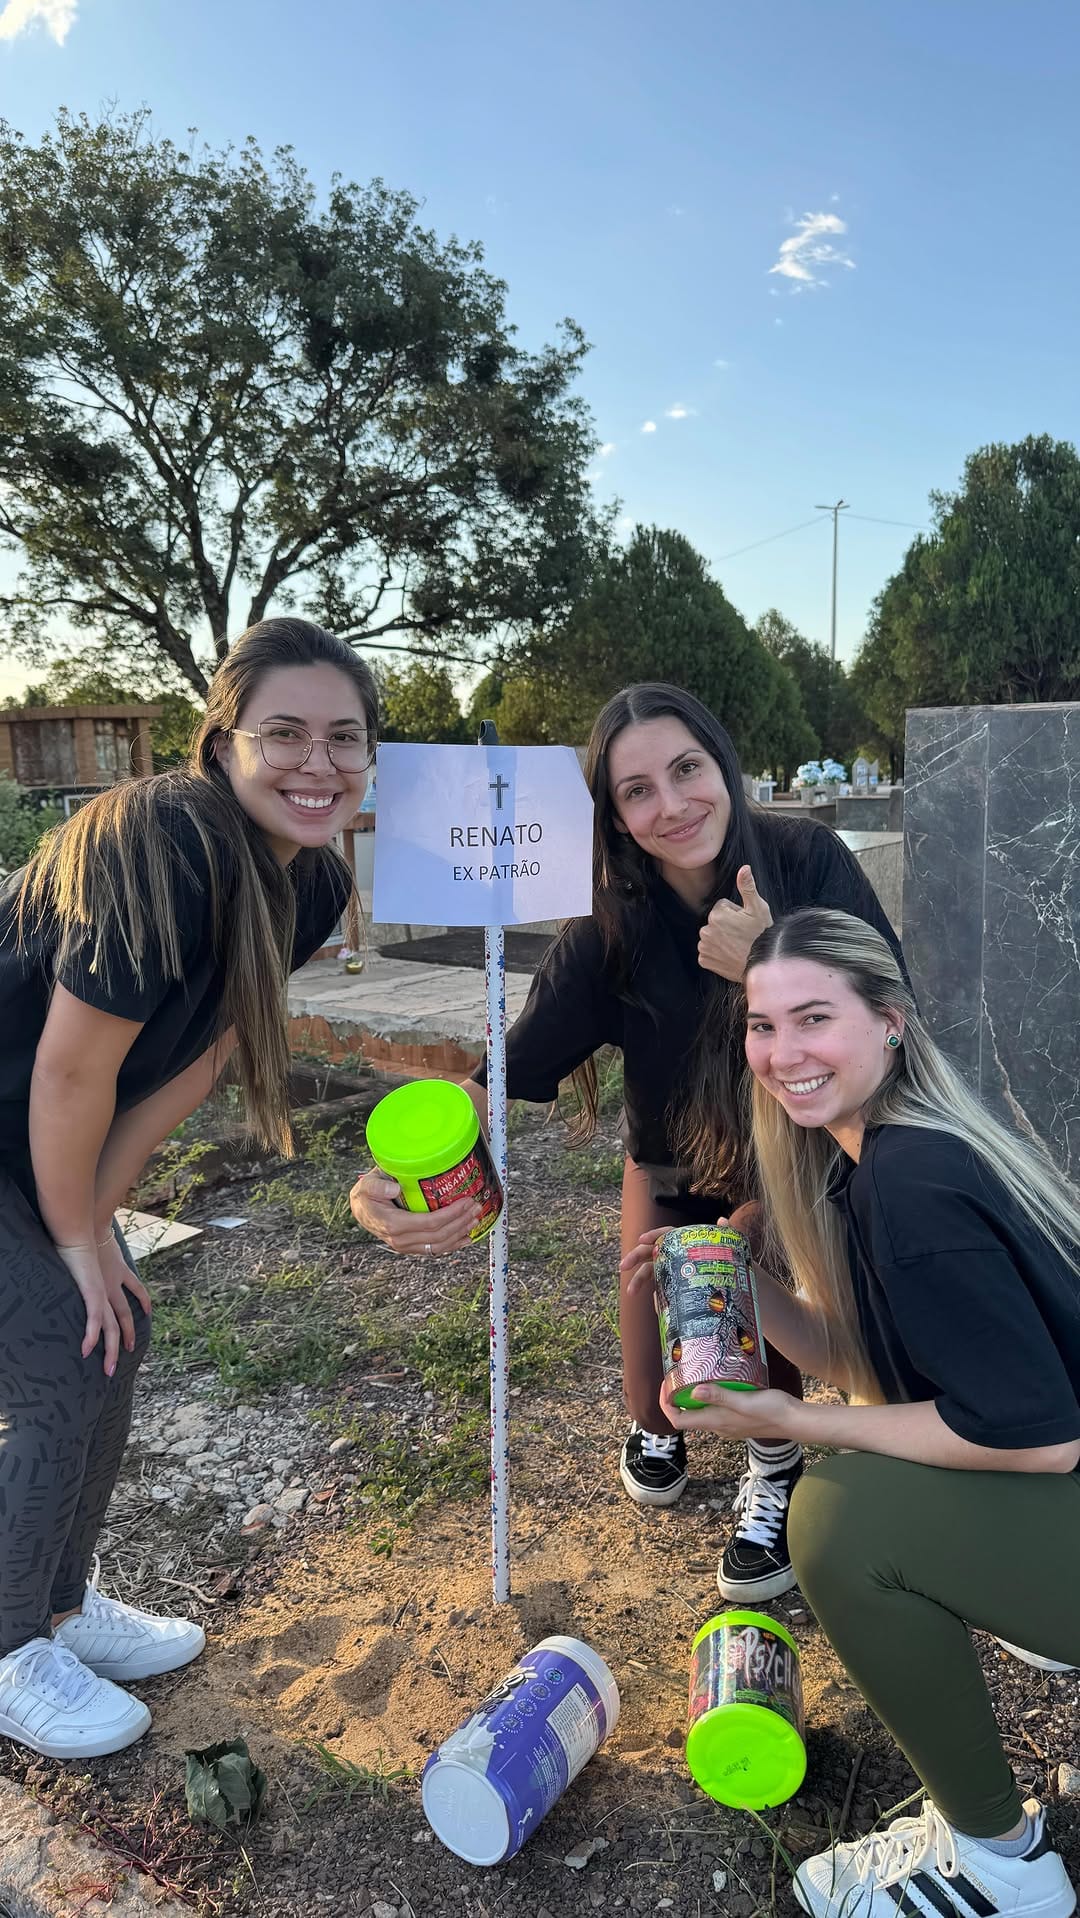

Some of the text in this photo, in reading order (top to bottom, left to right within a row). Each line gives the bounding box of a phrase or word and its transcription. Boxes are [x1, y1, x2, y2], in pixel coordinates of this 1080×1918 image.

[450, 823, 543, 847] RENATO
[453, 859, 541, 881] EX PATRÃO
[960, 1863, 998, 1904] SUPERSTAR
